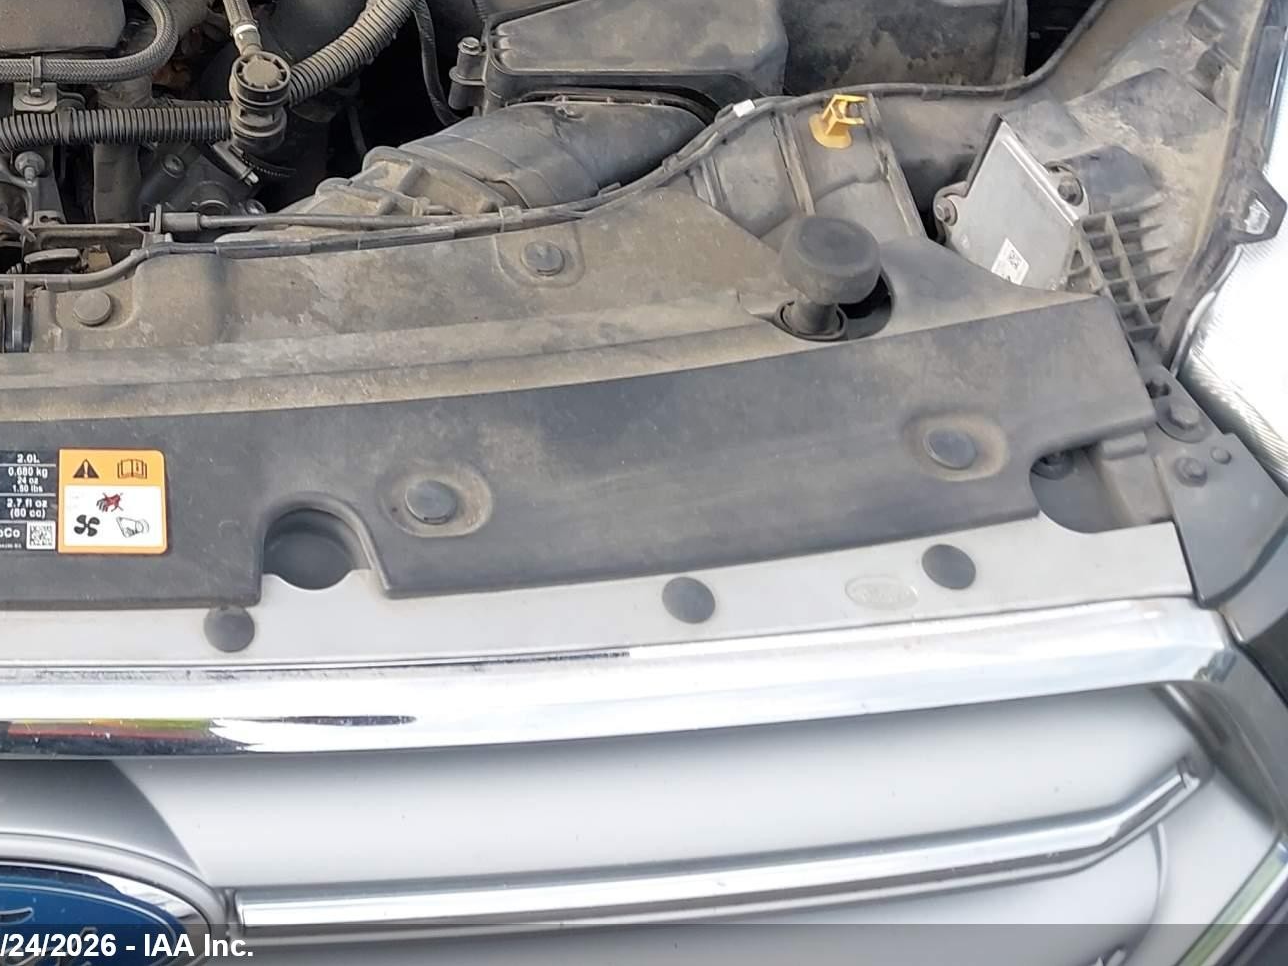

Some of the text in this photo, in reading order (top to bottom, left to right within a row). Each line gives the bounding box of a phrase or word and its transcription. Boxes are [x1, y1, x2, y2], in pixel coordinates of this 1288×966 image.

[16, 454, 41, 464] 2.0L
[35, 467, 48, 479] kg
[6, 498, 48, 508] 2.7 fl oz
[28, 508, 47, 519] cc)
